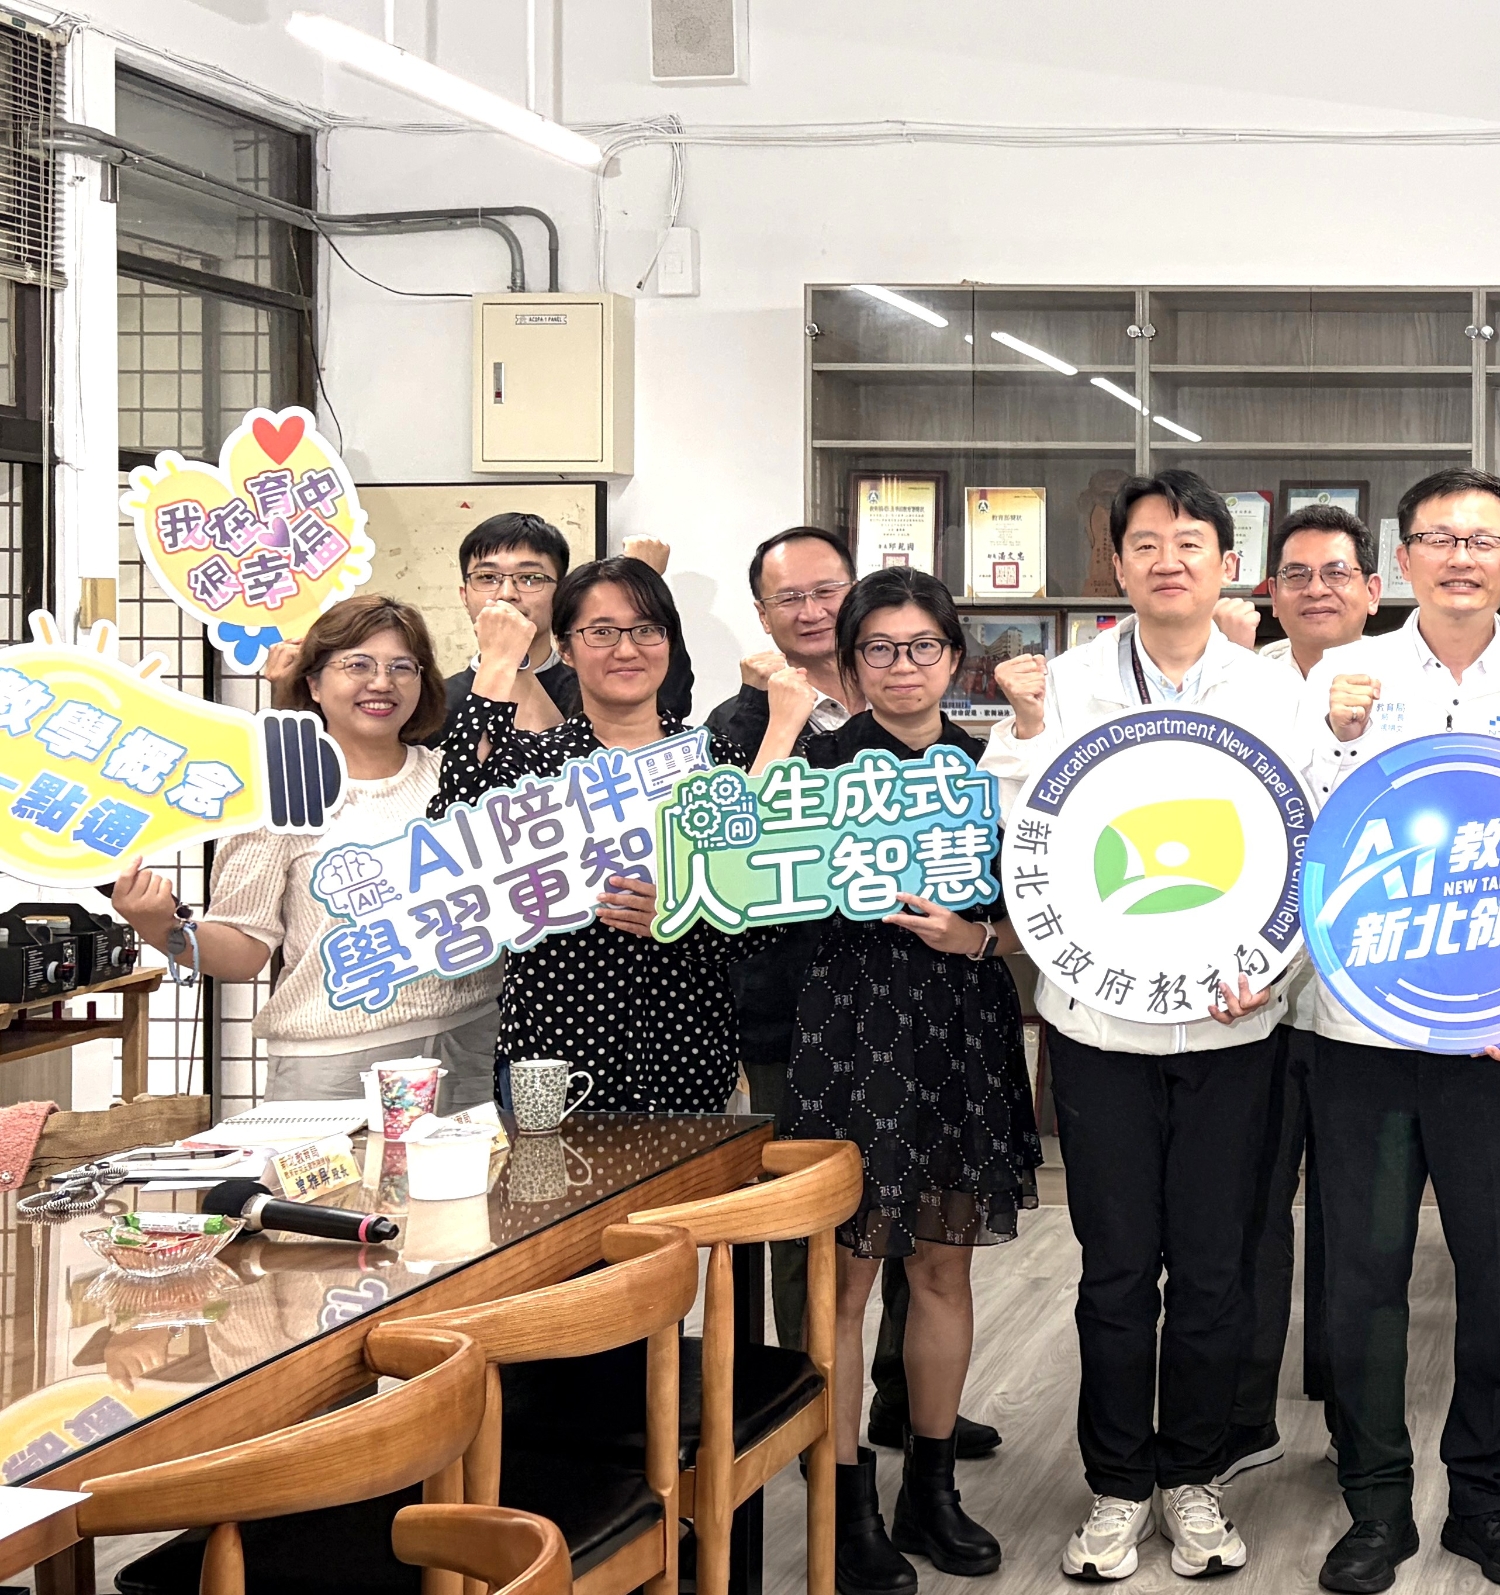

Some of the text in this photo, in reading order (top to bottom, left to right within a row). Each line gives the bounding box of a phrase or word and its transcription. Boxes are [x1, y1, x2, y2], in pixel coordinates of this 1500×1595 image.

[159, 470, 345, 550] 我在育中
[190, 515, 347, 609] 很幸福
[761, 753, 970, 831] 生成式
[1038, 736, 1110, 805] Education
[1108, 717, 1216, 745] Department
[1216, 727, 1253, 760] New
[1252, 752, 1293, 798] Taipei
[1285, 797, 1305, 829] City
[409, 754, 638, 893] AI陪伴
[731, 820, 750, 838] AI
[358, 889, 377, 910] AI
[661, 823, 995, 934] 人工智慧
[1013, 819, 1270, 1015] 新北市政府教育局
[1443, 878, 1480, 897] NEW
